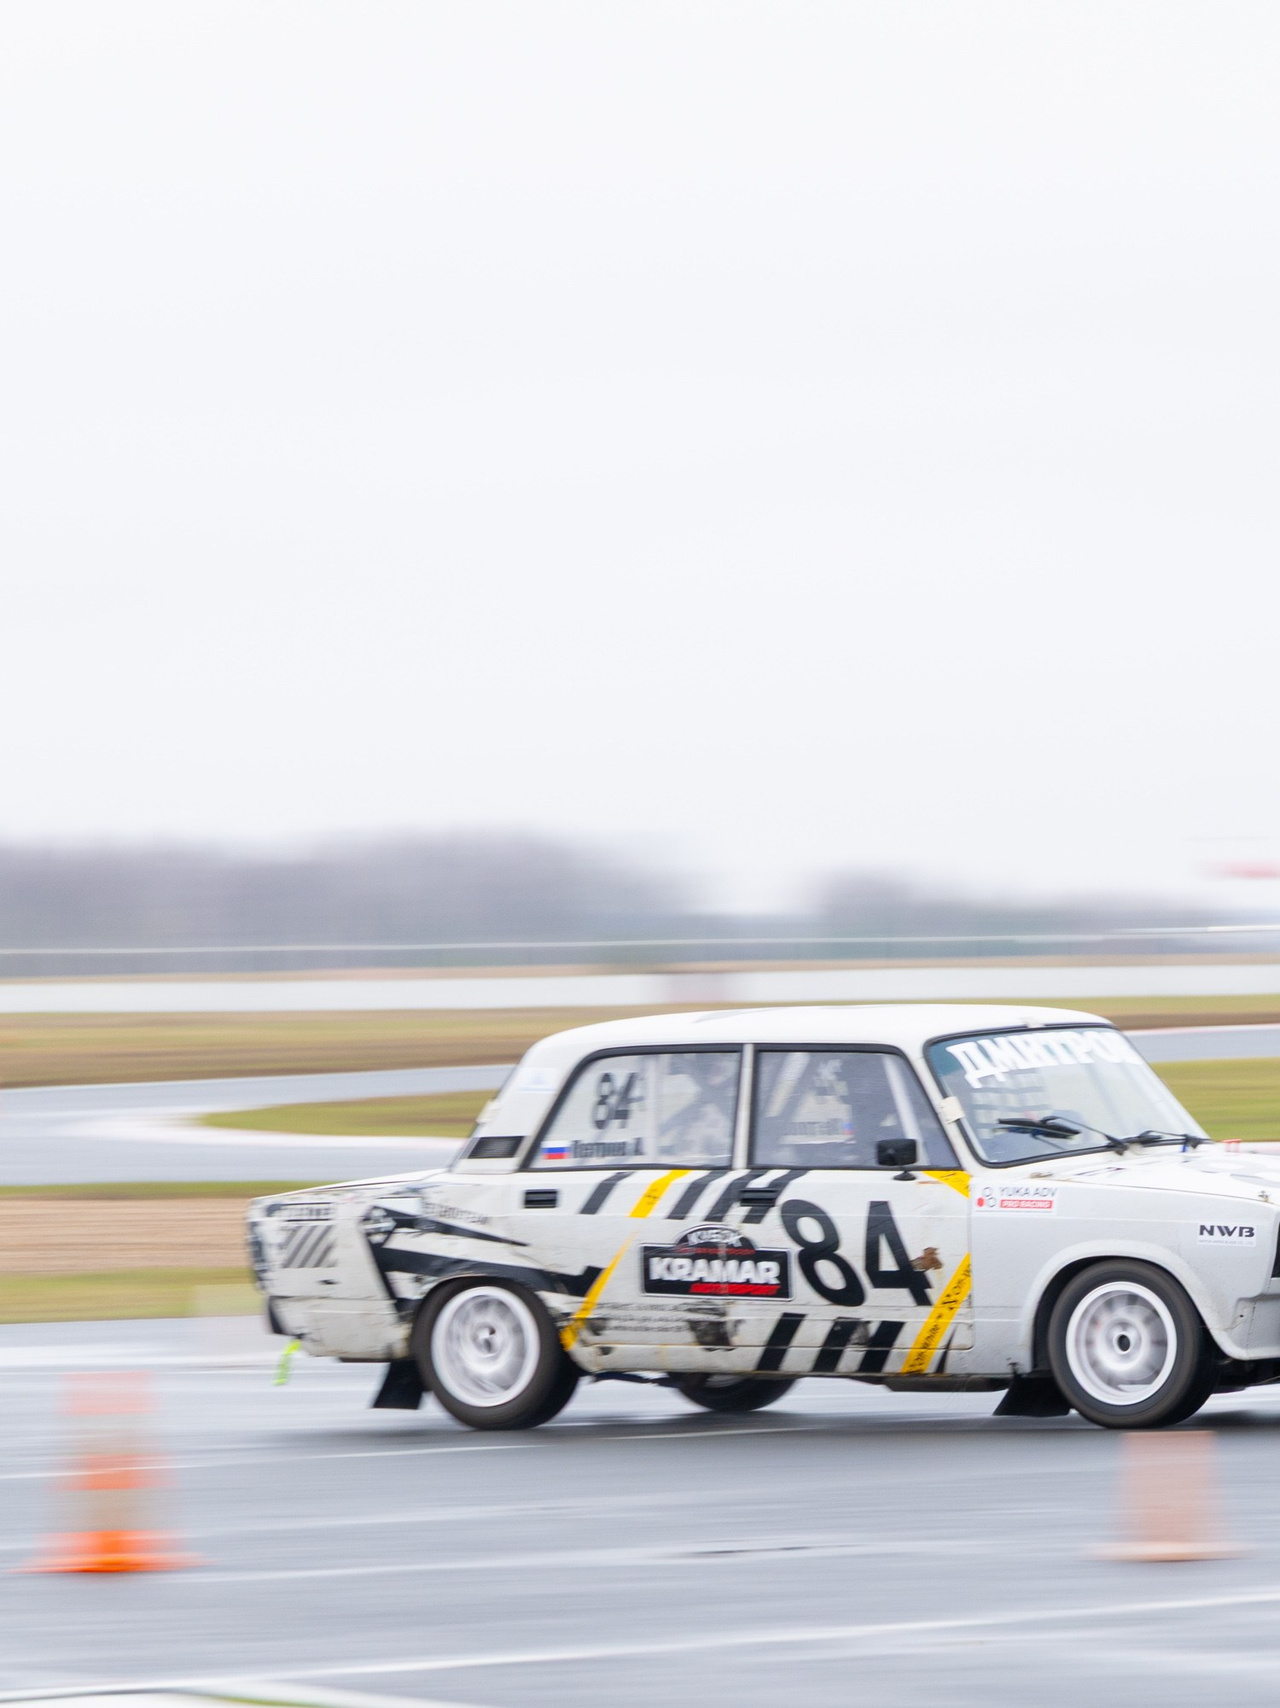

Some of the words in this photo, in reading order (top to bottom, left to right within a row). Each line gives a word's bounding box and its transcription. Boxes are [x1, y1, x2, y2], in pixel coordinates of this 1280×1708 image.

[592, 1072, 644, 1130] 84
[781, 1199, 933, 1307] 84
[1199, 1225, 1255, 1238] NWB
[649, 1257, 781, 1285] KRAMAR
